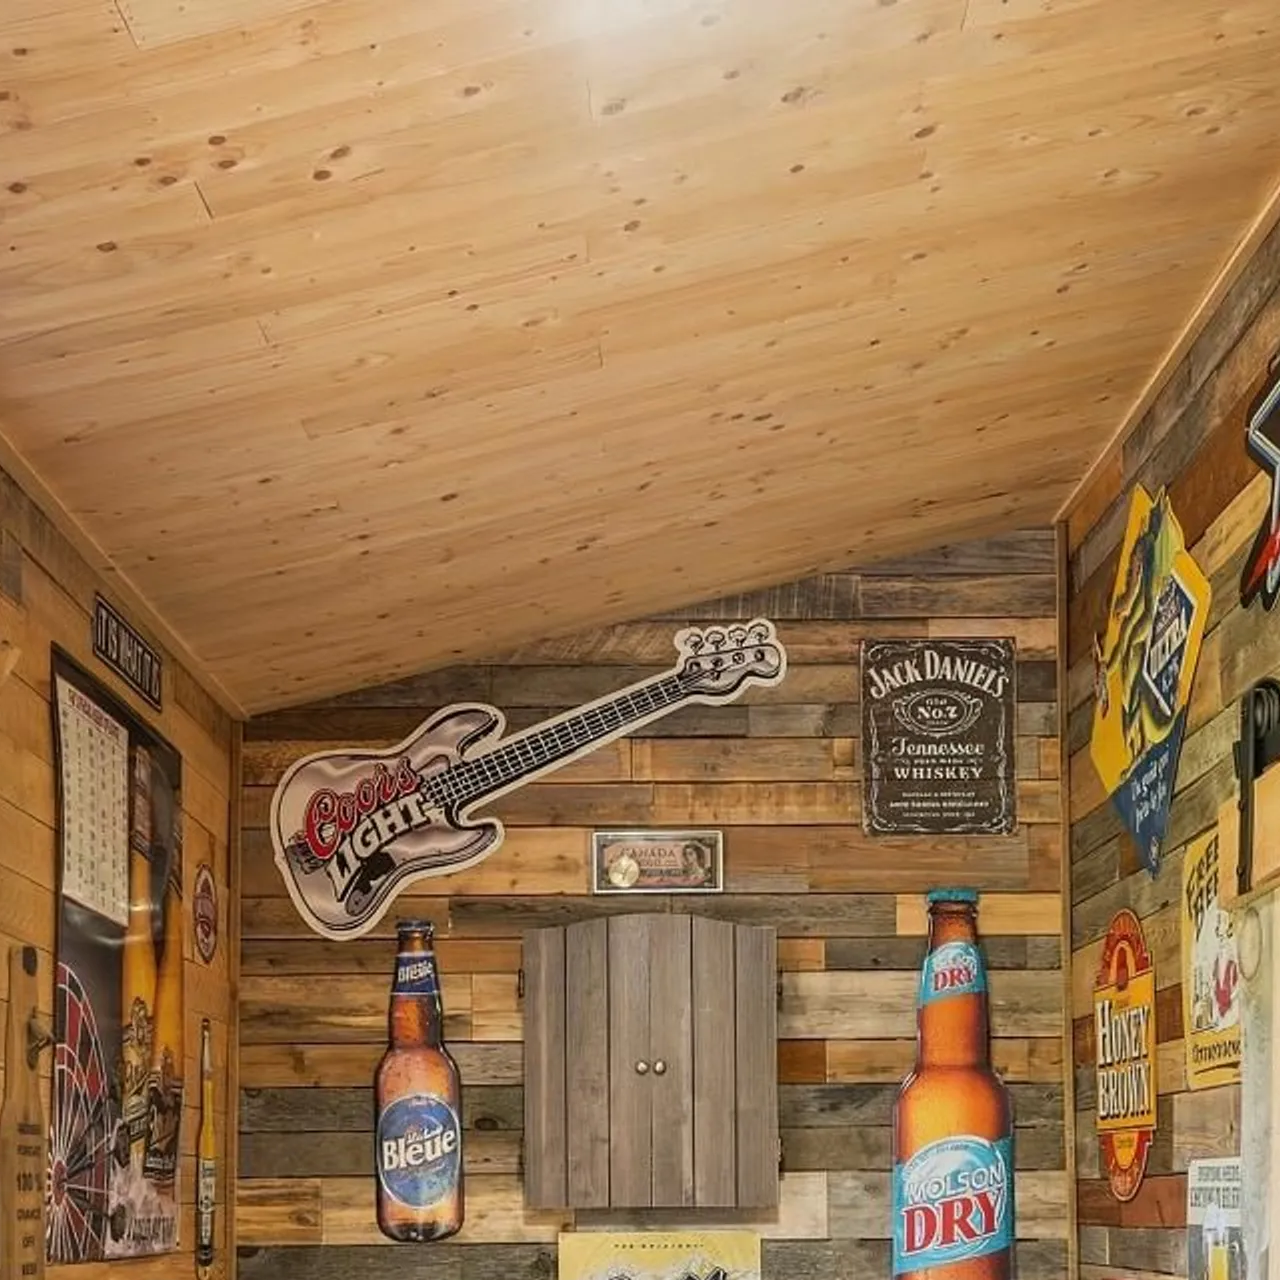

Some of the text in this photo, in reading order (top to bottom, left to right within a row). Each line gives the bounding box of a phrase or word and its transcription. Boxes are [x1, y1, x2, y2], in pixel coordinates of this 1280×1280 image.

[869, 650, 1010, 699] JACK DANIEL'S
[891, 737, 985, 756] Tennessee
[894, 766, 983, 779] WHISKEY
[304, 756, 418, 860] Coors
[325, 792, 431, 902] LIGHT
[620, 847, 676, 858] CANADA
[934, 967, 974, 991] DRY
[1098, 999, 1150, 1068] HONEY
[1098, 1061, 1151, 1119] BROWN
[382, 1129, 456, 1171] Bleue
[908, 1162, 1004, 1204] MOLSON
[901, 1188, 1003, 1257] DRY
